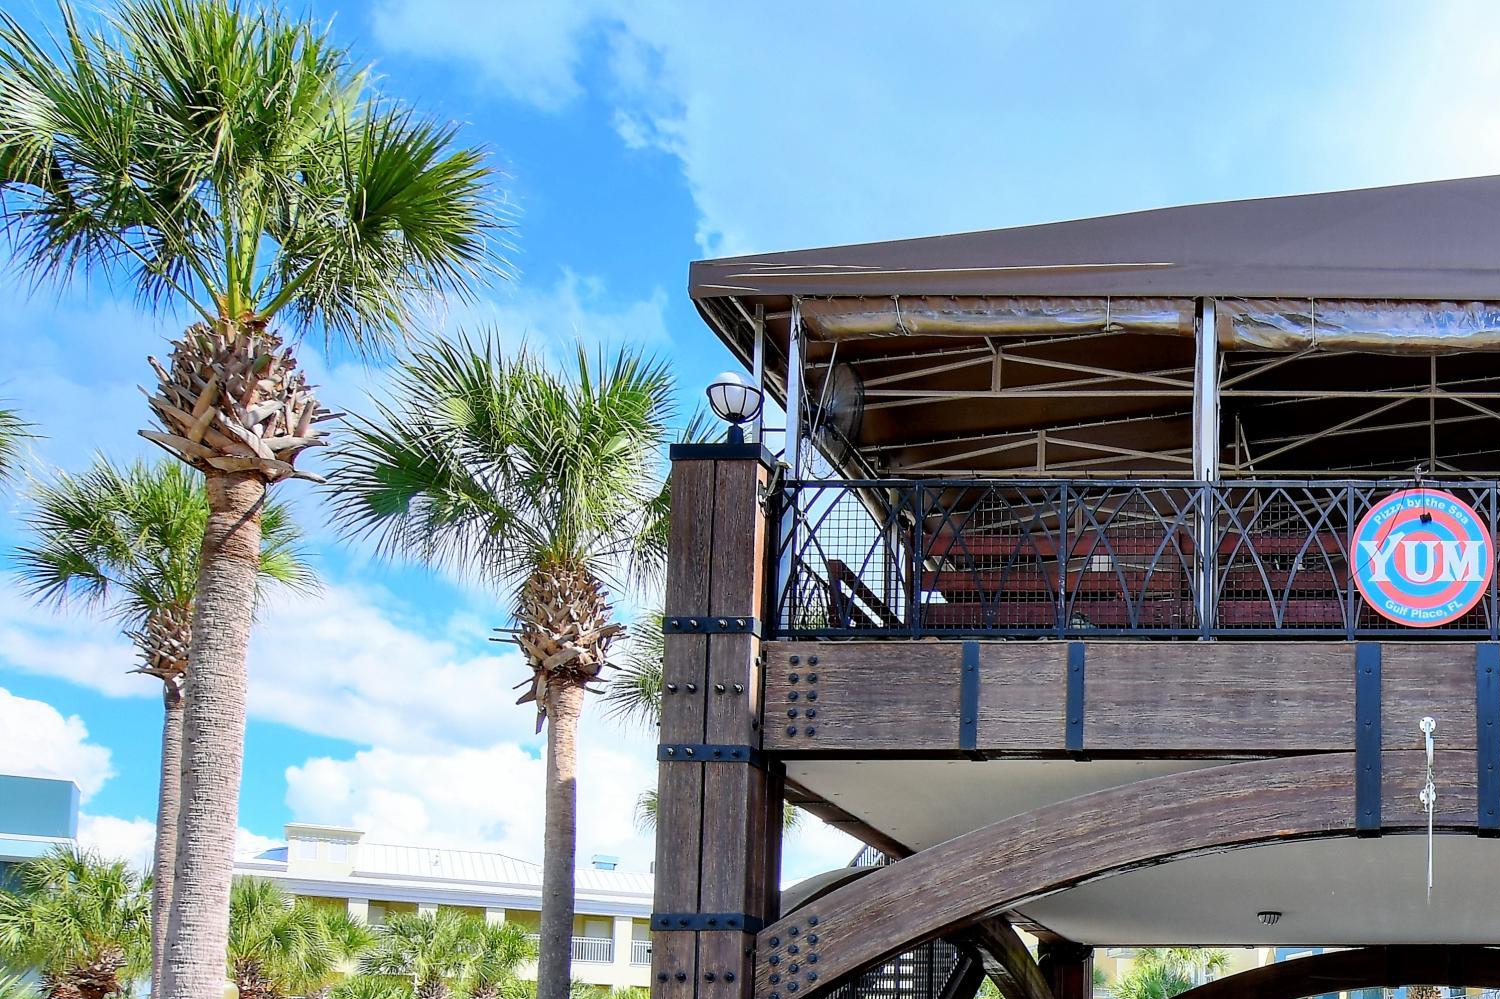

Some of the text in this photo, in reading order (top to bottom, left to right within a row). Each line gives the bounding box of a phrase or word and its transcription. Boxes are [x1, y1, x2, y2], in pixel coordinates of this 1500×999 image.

[1374, 498, 1470, 525] Pizza by the Sea
[1358, 531, 1485, 582] YUM
[1385, 600, 1463, 619] Gulf Place, FL
